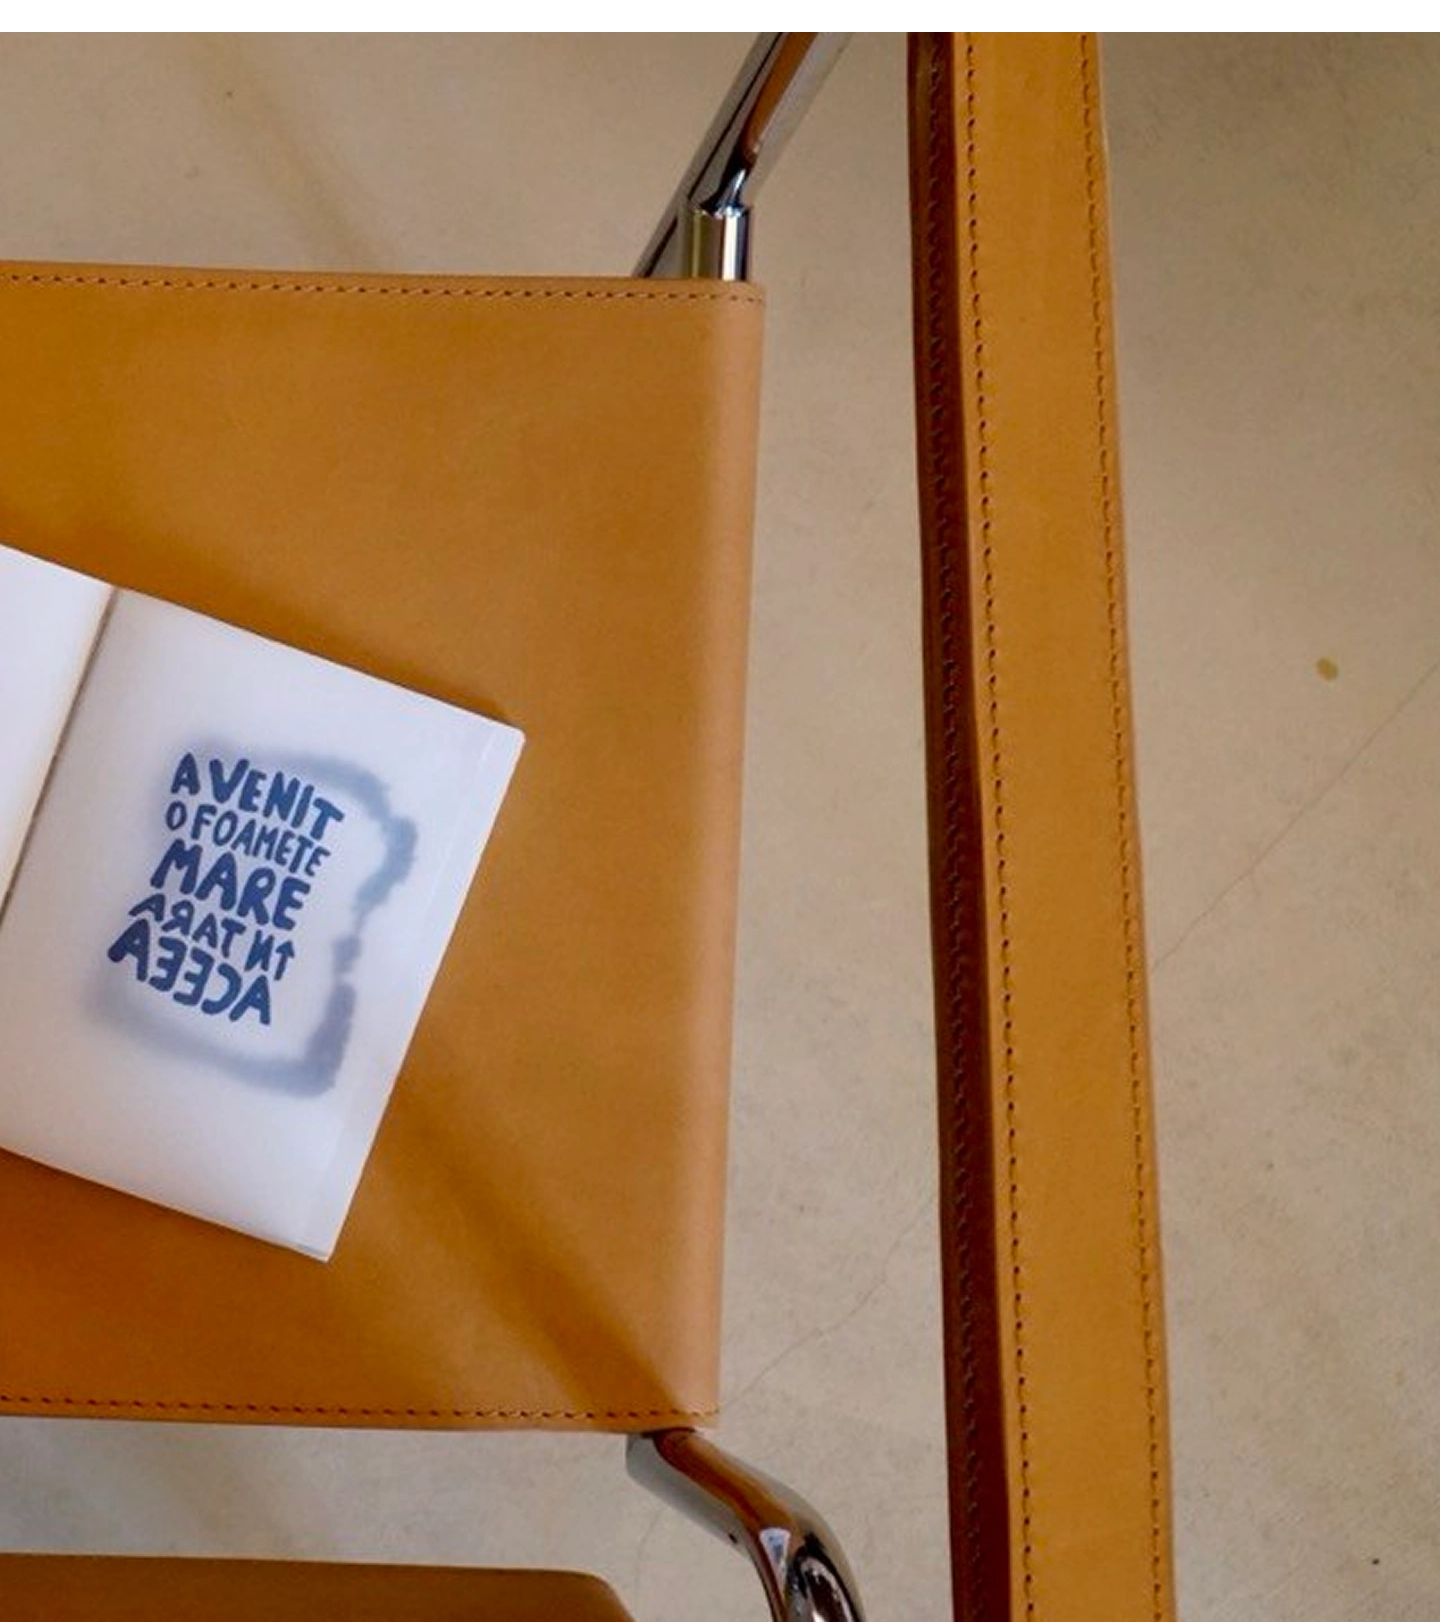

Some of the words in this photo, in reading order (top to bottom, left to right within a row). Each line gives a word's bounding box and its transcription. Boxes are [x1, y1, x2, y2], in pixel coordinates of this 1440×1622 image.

[165, 800, 188, 831] O
[190, 803, 332, 877] FOAMETE
[170, 752, 201, 796] A
[209, 758, 346, 840] VENIT
[150, 838, 312, 931] MARE
